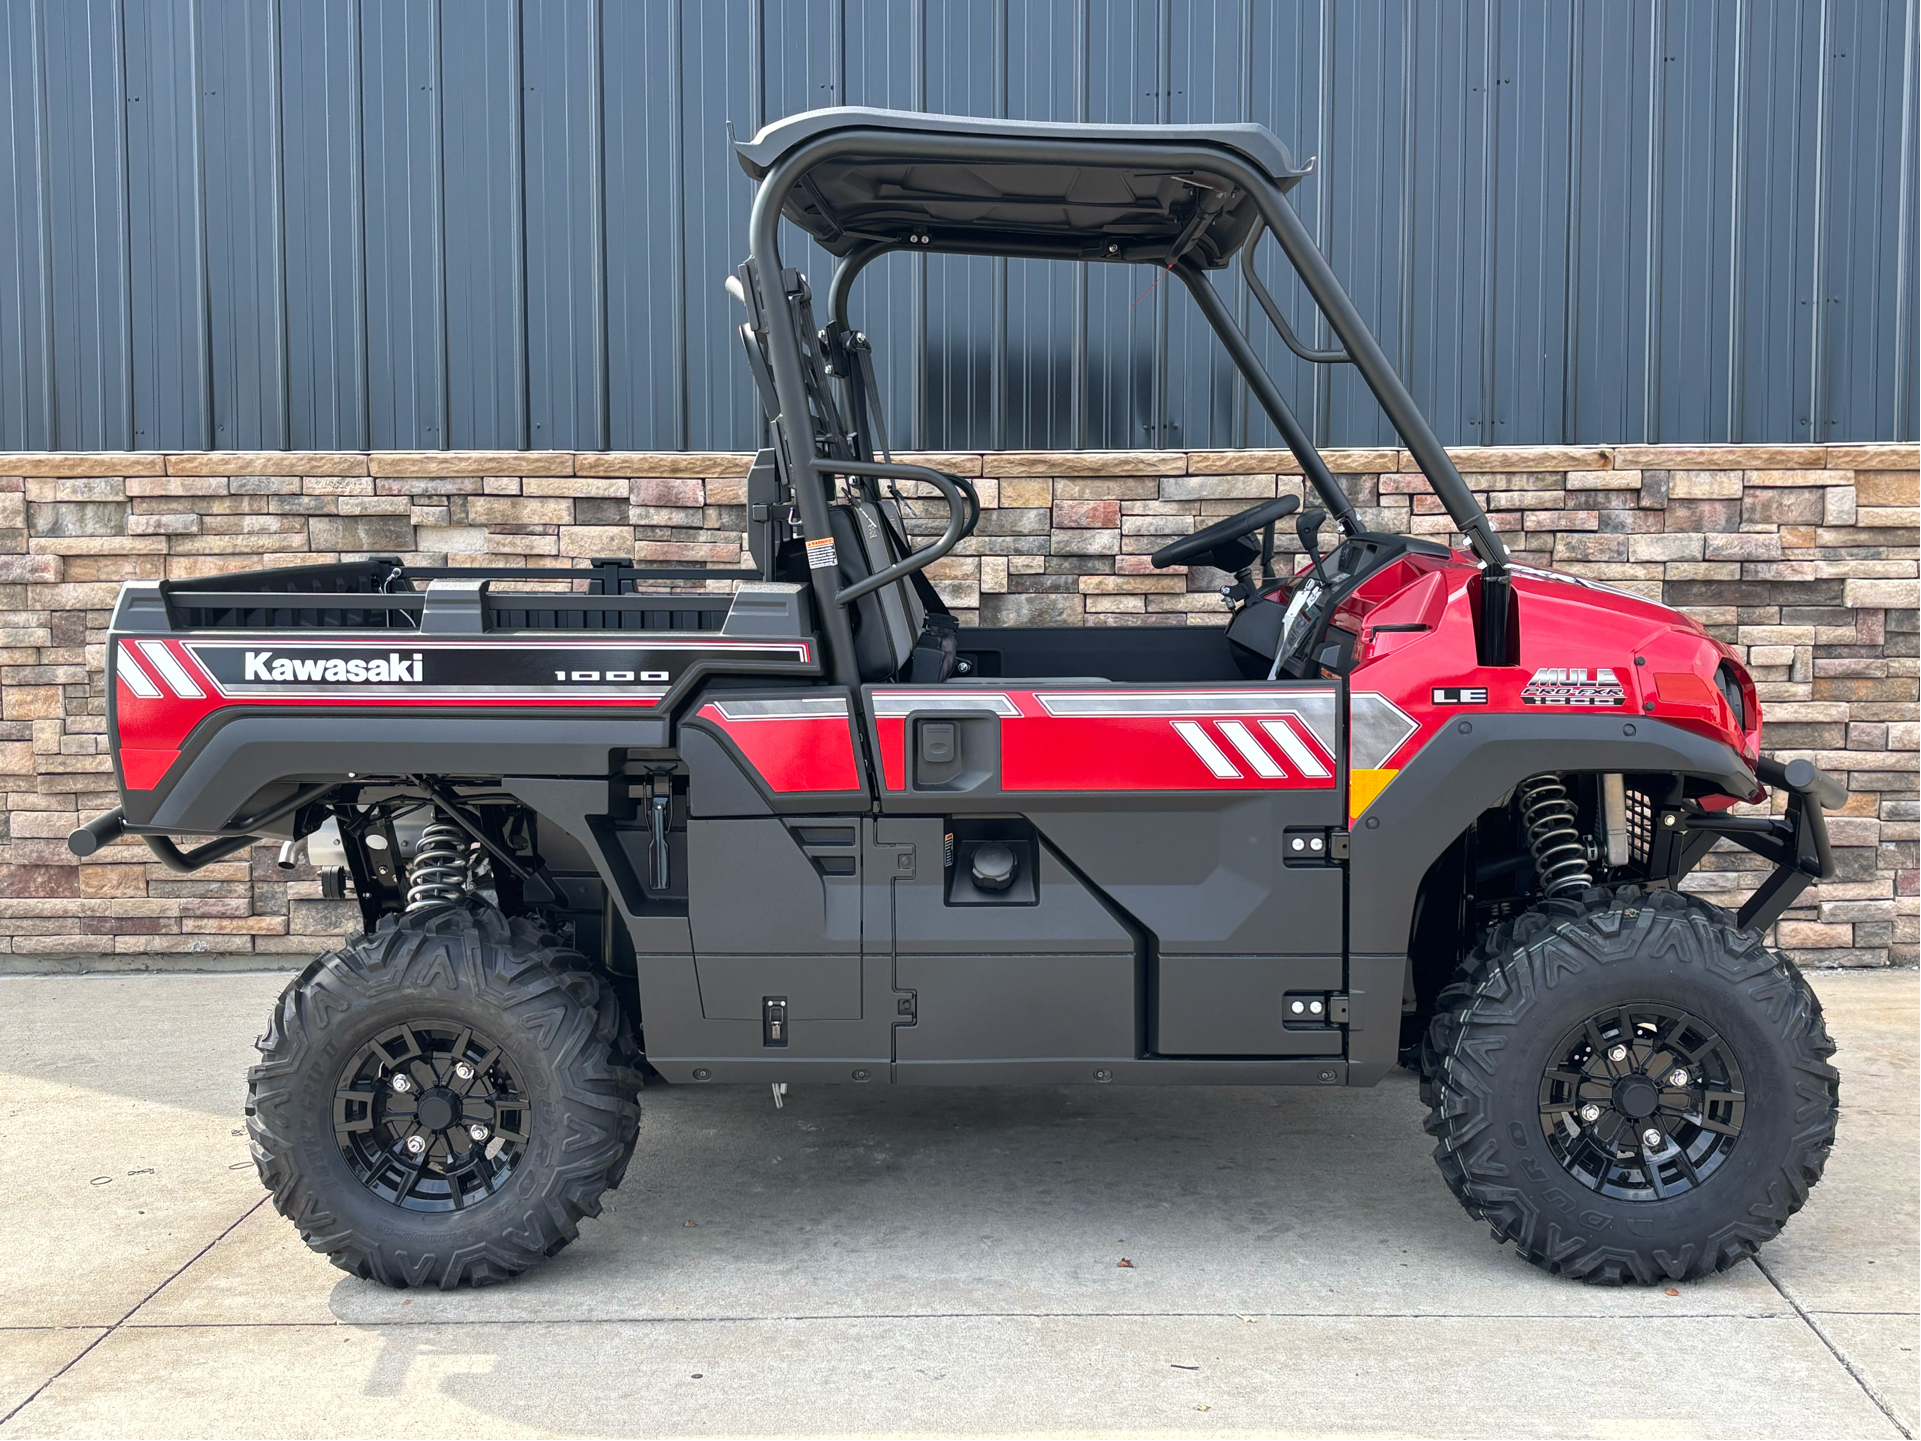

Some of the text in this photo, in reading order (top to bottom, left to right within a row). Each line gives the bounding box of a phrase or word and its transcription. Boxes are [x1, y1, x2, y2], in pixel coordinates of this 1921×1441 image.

[245, 652, 423, 682] Kawasaki
[555, 671, 669, 681] 1000
[1526, 667, 1622, 687] MULE
[1434, 689, 1486, 702] LE
[1521, 687, 1625, 697] PRO-FXR
[517, 1063, 558, 1200] DURO
[1507, 1120, 1614, 1232] DURO
